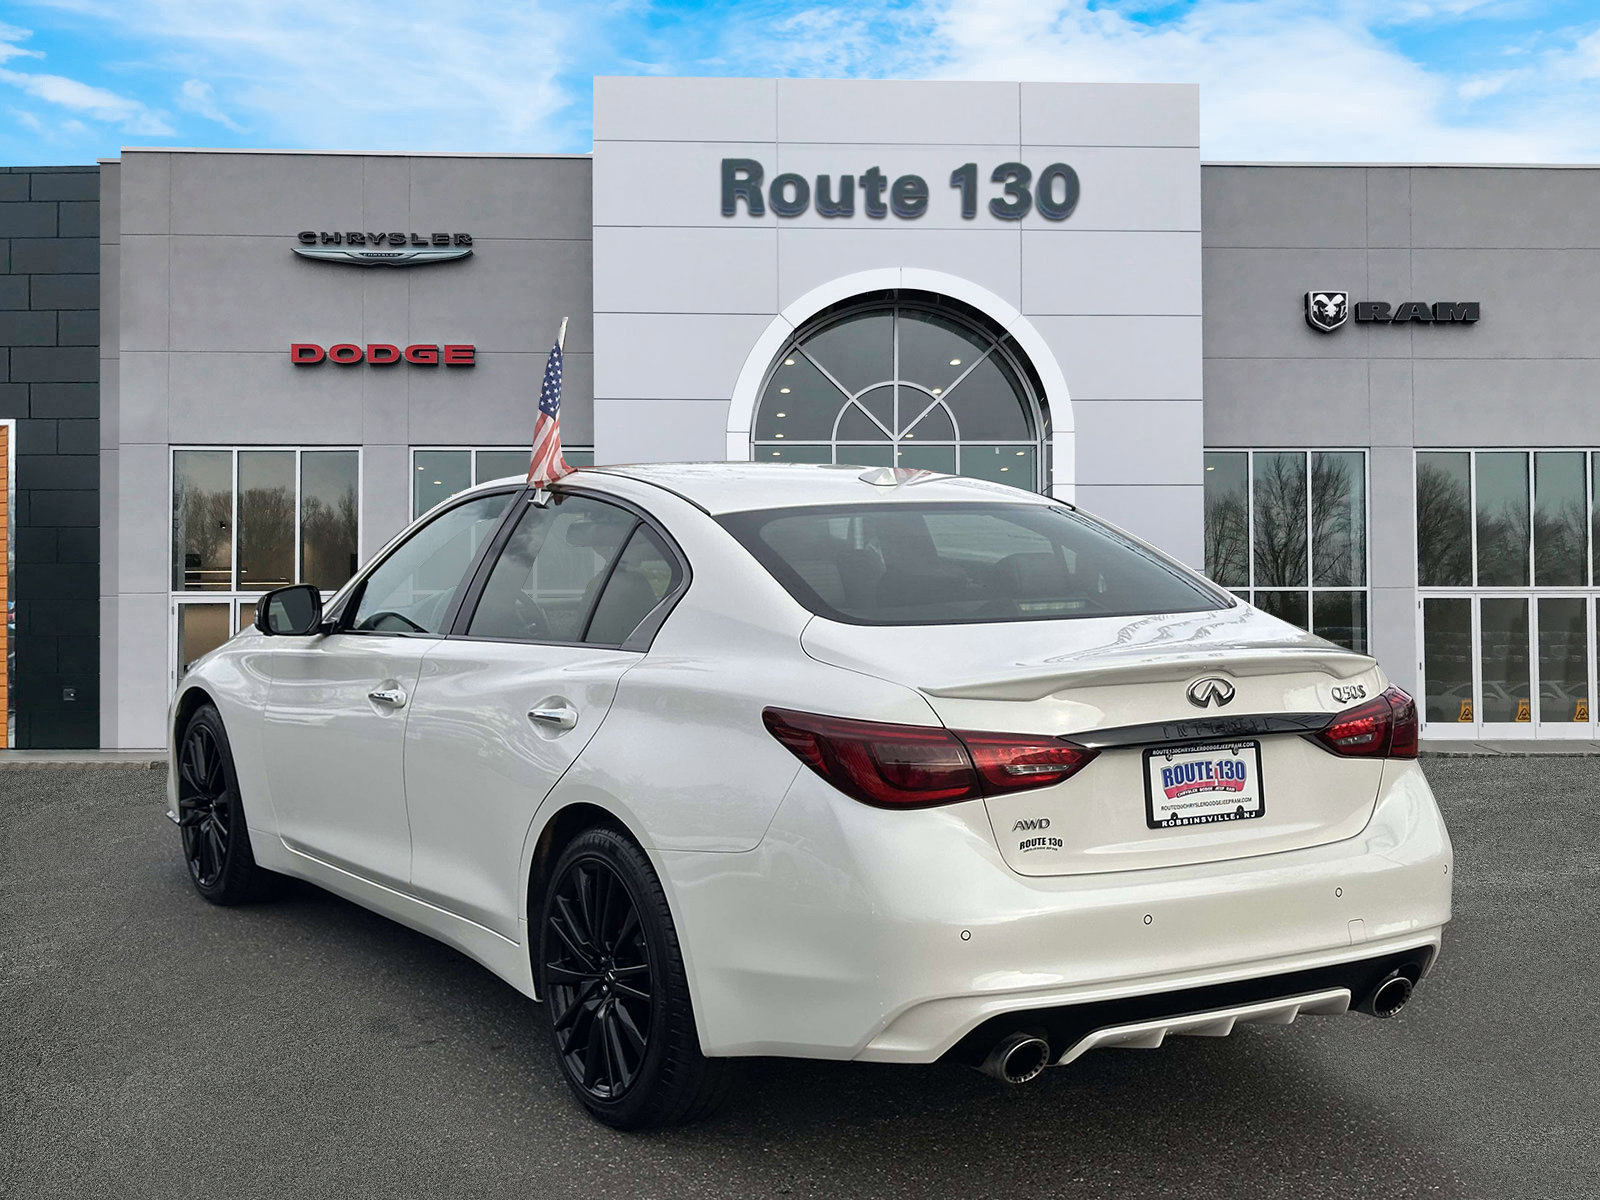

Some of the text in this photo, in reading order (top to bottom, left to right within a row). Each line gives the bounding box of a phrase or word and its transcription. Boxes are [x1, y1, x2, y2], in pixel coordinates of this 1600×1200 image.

[721, 158, 1080, 220] Route 130
[298, 231, 473, 246] CHRYSLER
[1355, 302, 1480, 323] RAM
[291, 343, 476, 366] DODGE
[1331, 684, 1367, 704] Q50S
[1162, 760, 1246, 788] ROUTE 130
[1012, 818, 1051, 831] AWD
[1243, 811, 1256, 819] NJ
[1019, 837, 1047, 850] ROUTE
[1048, 837, 1063, 848] 130
